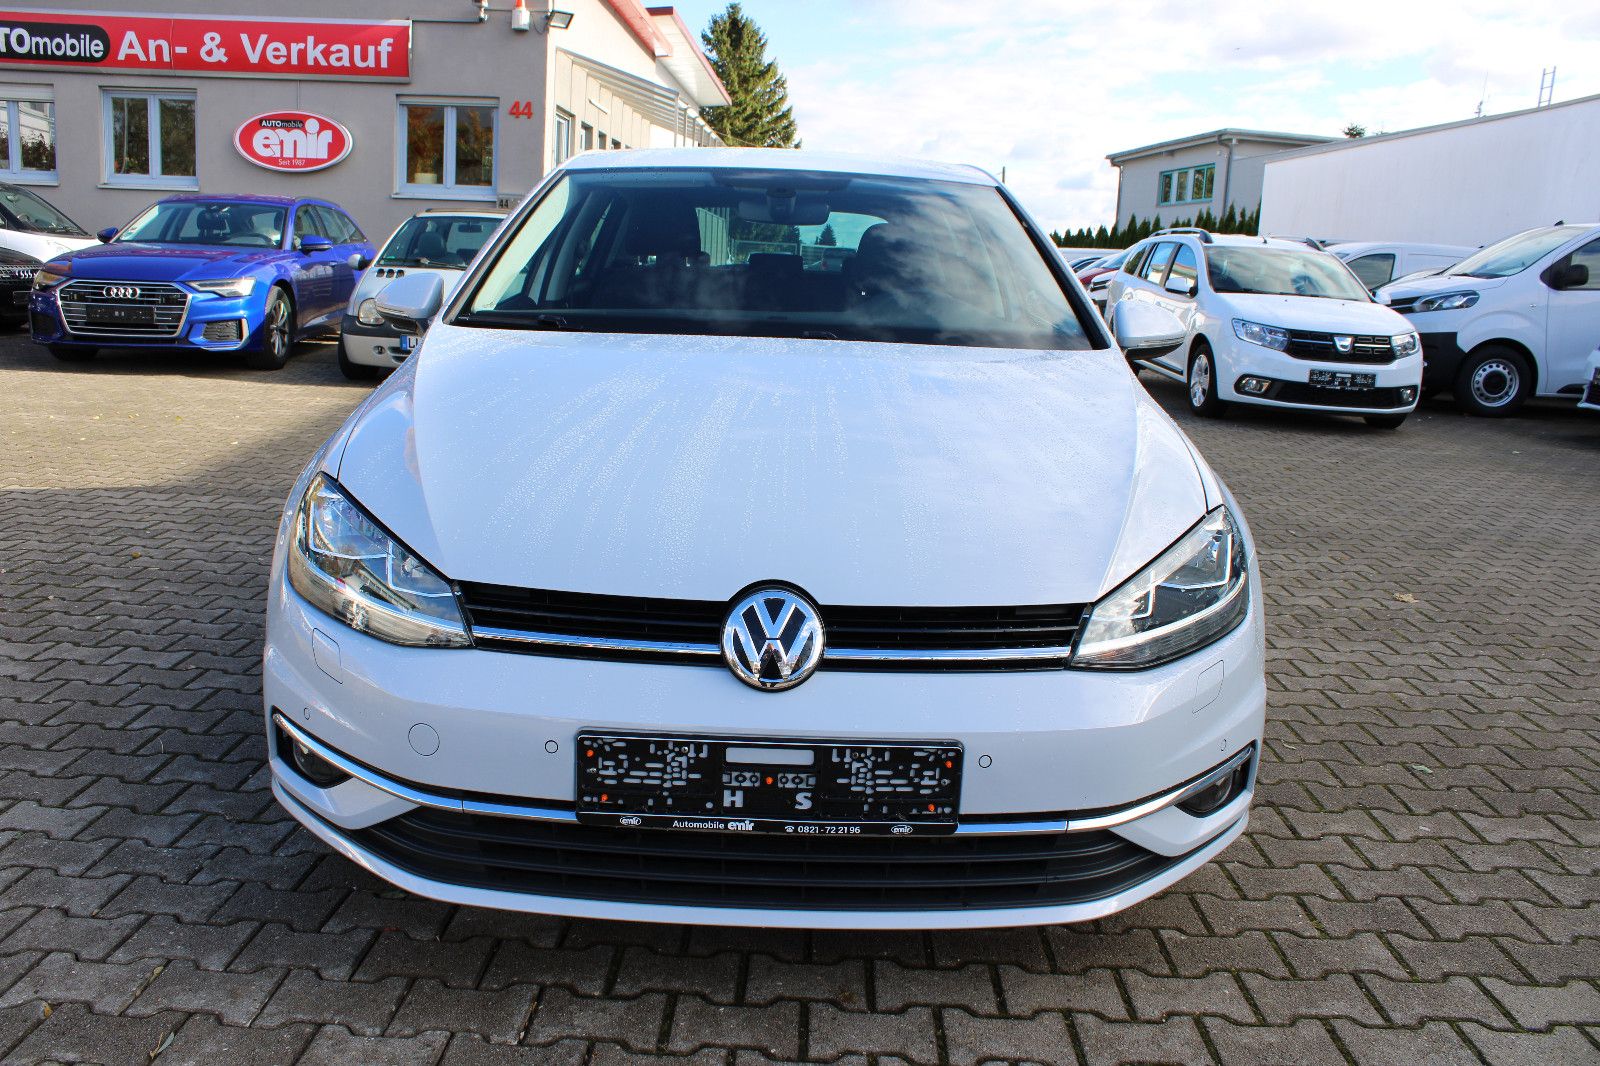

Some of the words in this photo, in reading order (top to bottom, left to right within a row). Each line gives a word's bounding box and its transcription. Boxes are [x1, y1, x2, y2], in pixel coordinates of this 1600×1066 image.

[117, 30, 188, 63] An-
[199, 31, 228, 63] &
[239, 32, 394, 69] Verkauf
[508, 100, 534, 119] 44
[261, 120, 304, 128] AUTOmobile
[252, 118, 333, 159] emir
[278, 158, 291, 166] Seit
[620, 816, 641, 827] emir
[672, 820, 725, 830] Automobile
[727, 819, 755, 831] emir
[891, 825, 913, 835] emir
